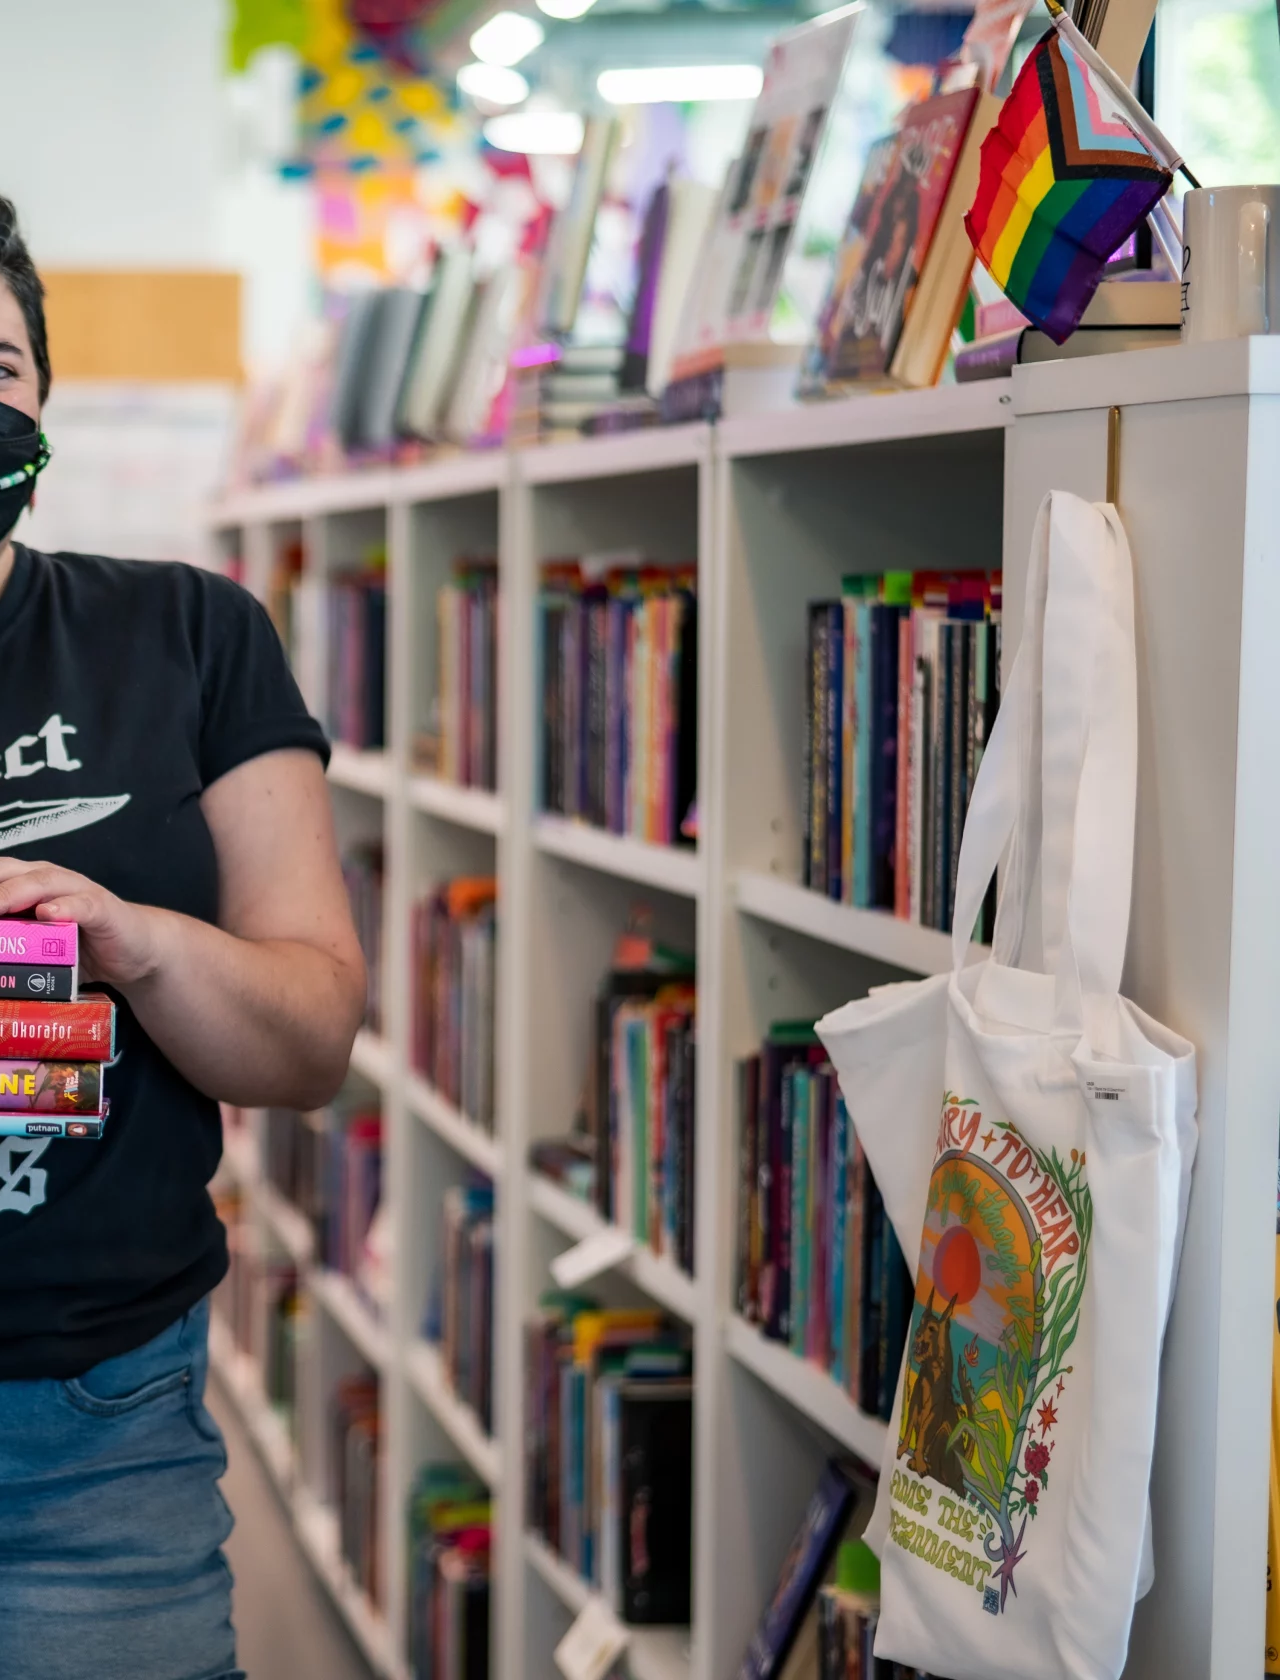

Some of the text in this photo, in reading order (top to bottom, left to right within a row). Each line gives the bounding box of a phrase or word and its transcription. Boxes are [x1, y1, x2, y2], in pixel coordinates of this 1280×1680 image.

[12, 1021, 72, 1041] Okorafor
[28, 1123, 60, 1134] putnam
[991, 1131, 1033, 1180] TO
[1025, 1174, 1080, 1280] HEAR
[937, 1495, 980, 1542] THE
